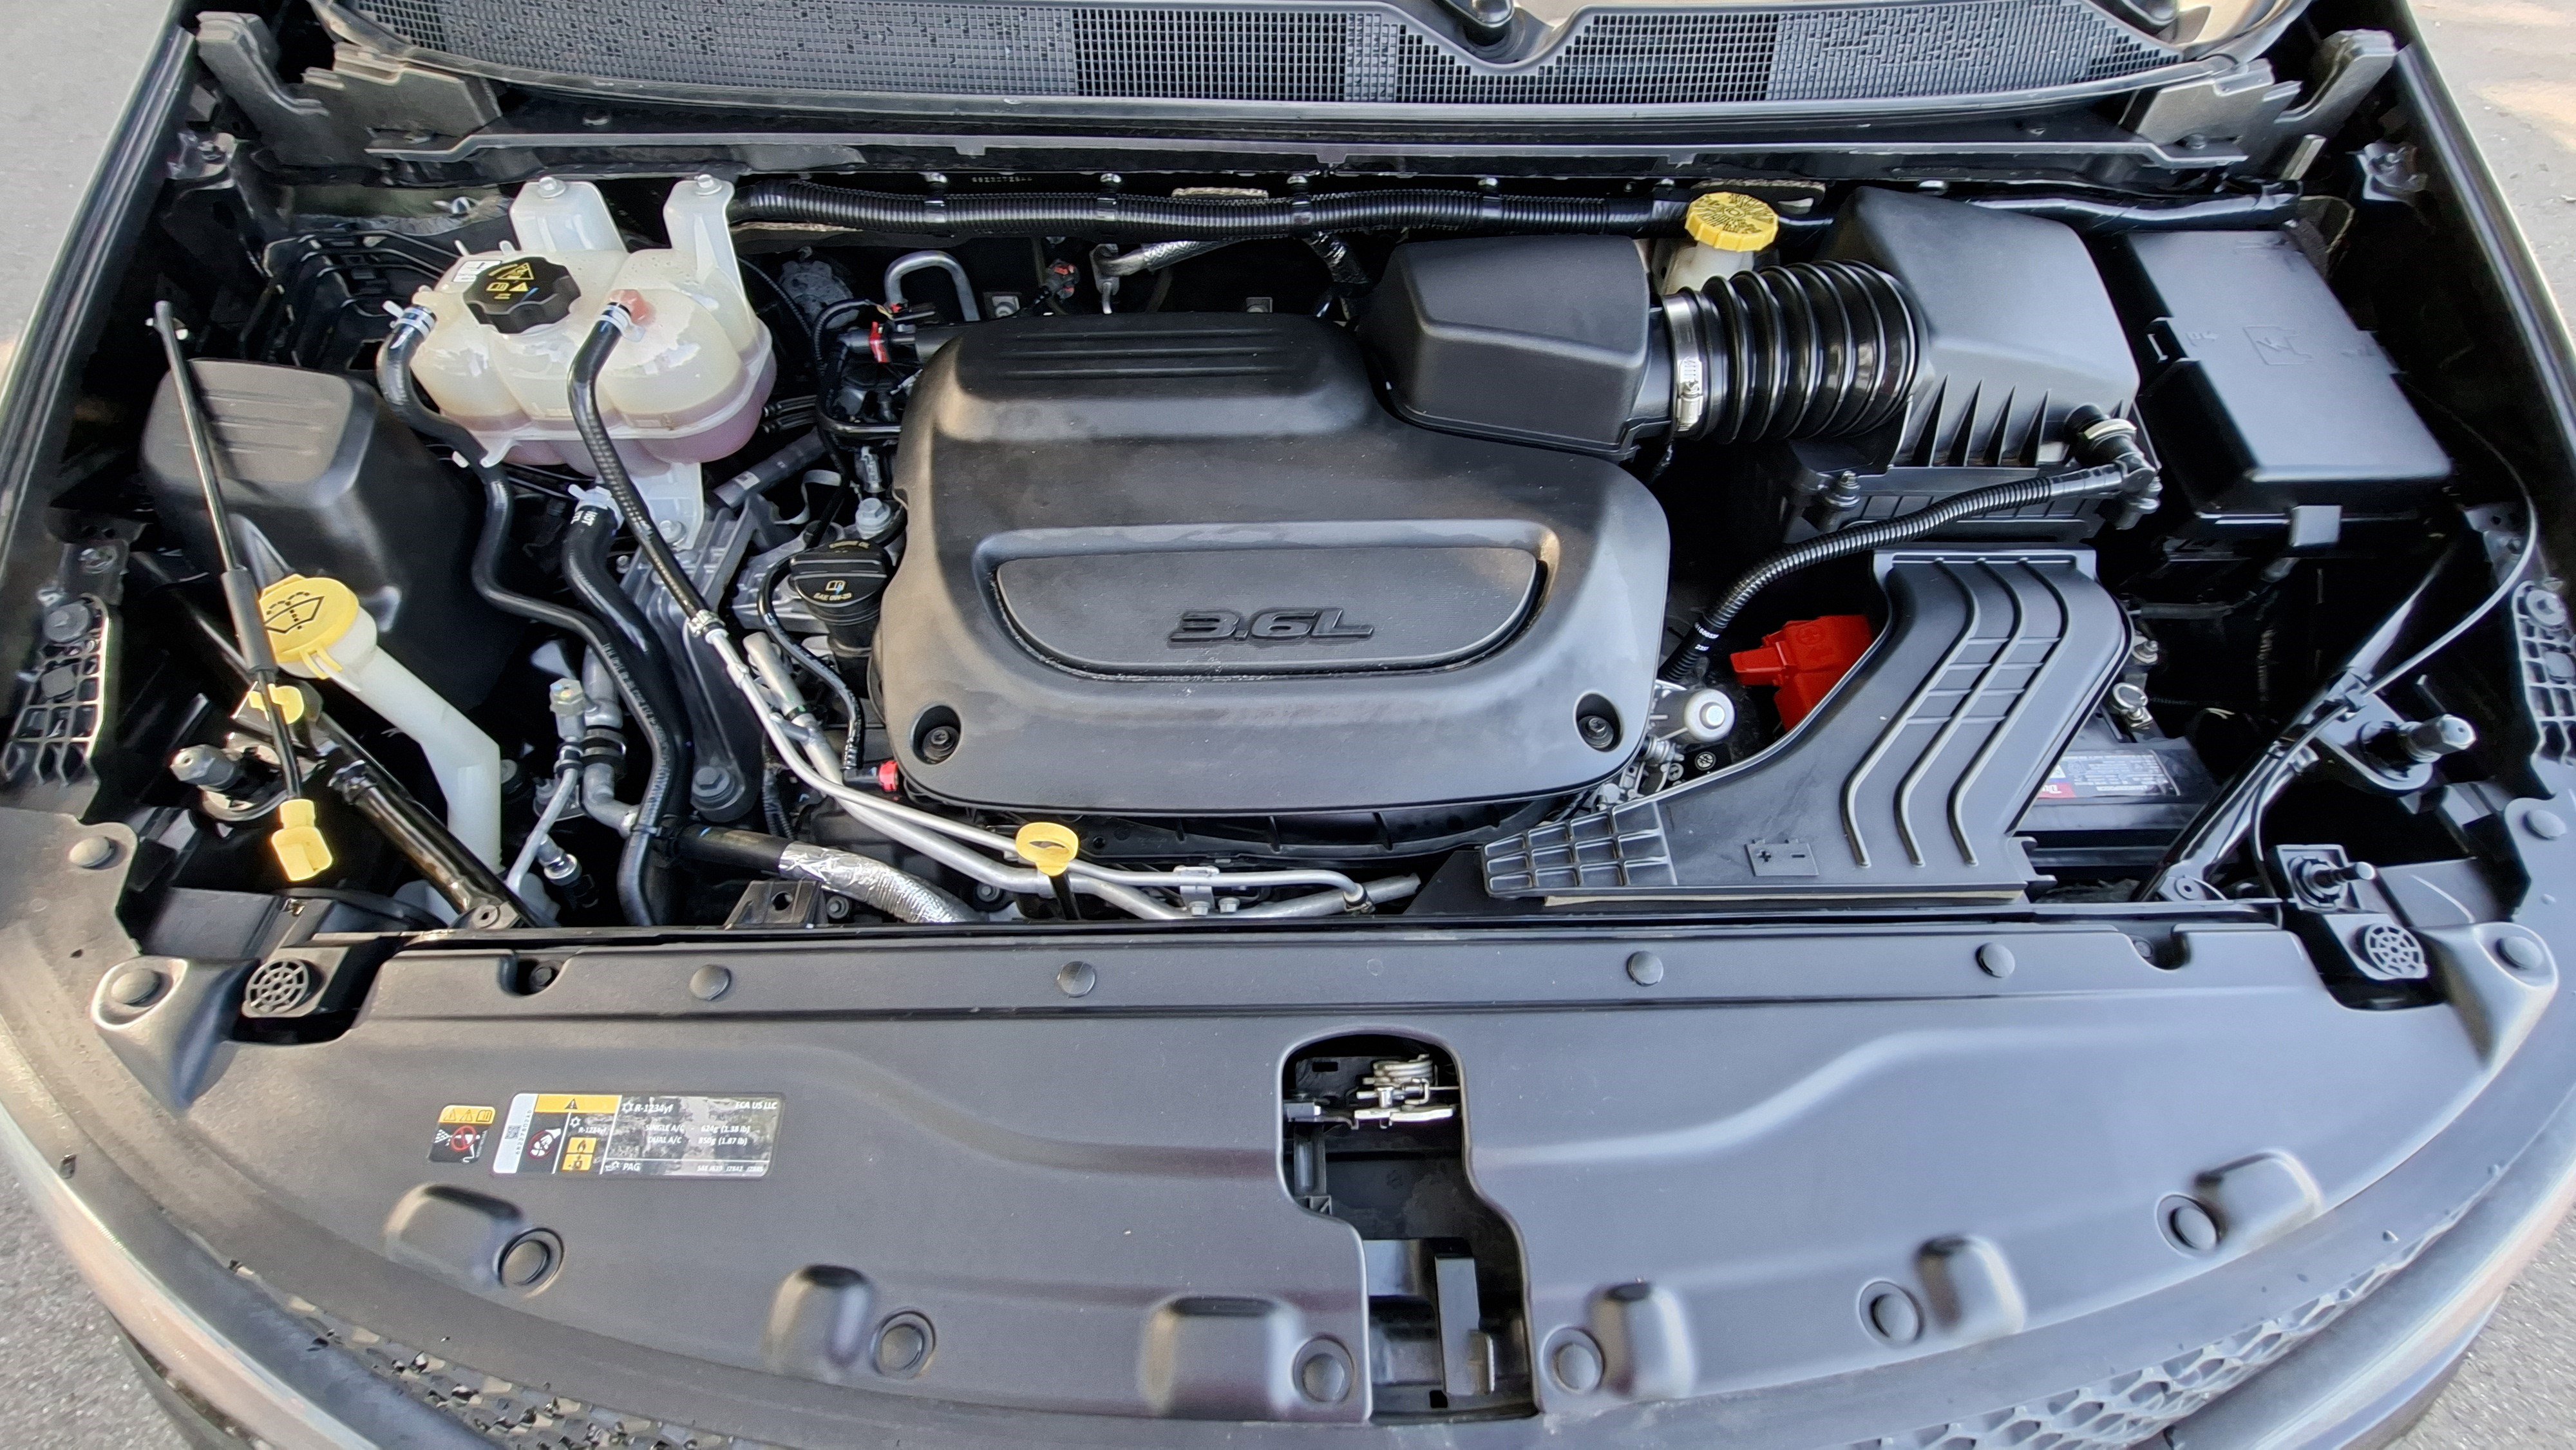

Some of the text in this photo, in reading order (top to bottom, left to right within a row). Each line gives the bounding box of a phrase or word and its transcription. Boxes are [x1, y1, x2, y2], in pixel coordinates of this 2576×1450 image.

[1168, 608, 1374, 643] 3.6L
[634, 1103, 674, 1115] R-1234yf
[668, 1124, 685, 1133] A/C
[739, 1125, 751, 1134] lb)
[668, 1136, 682, 1145] A/C
[737, 1137, 748, 1146] lb)
